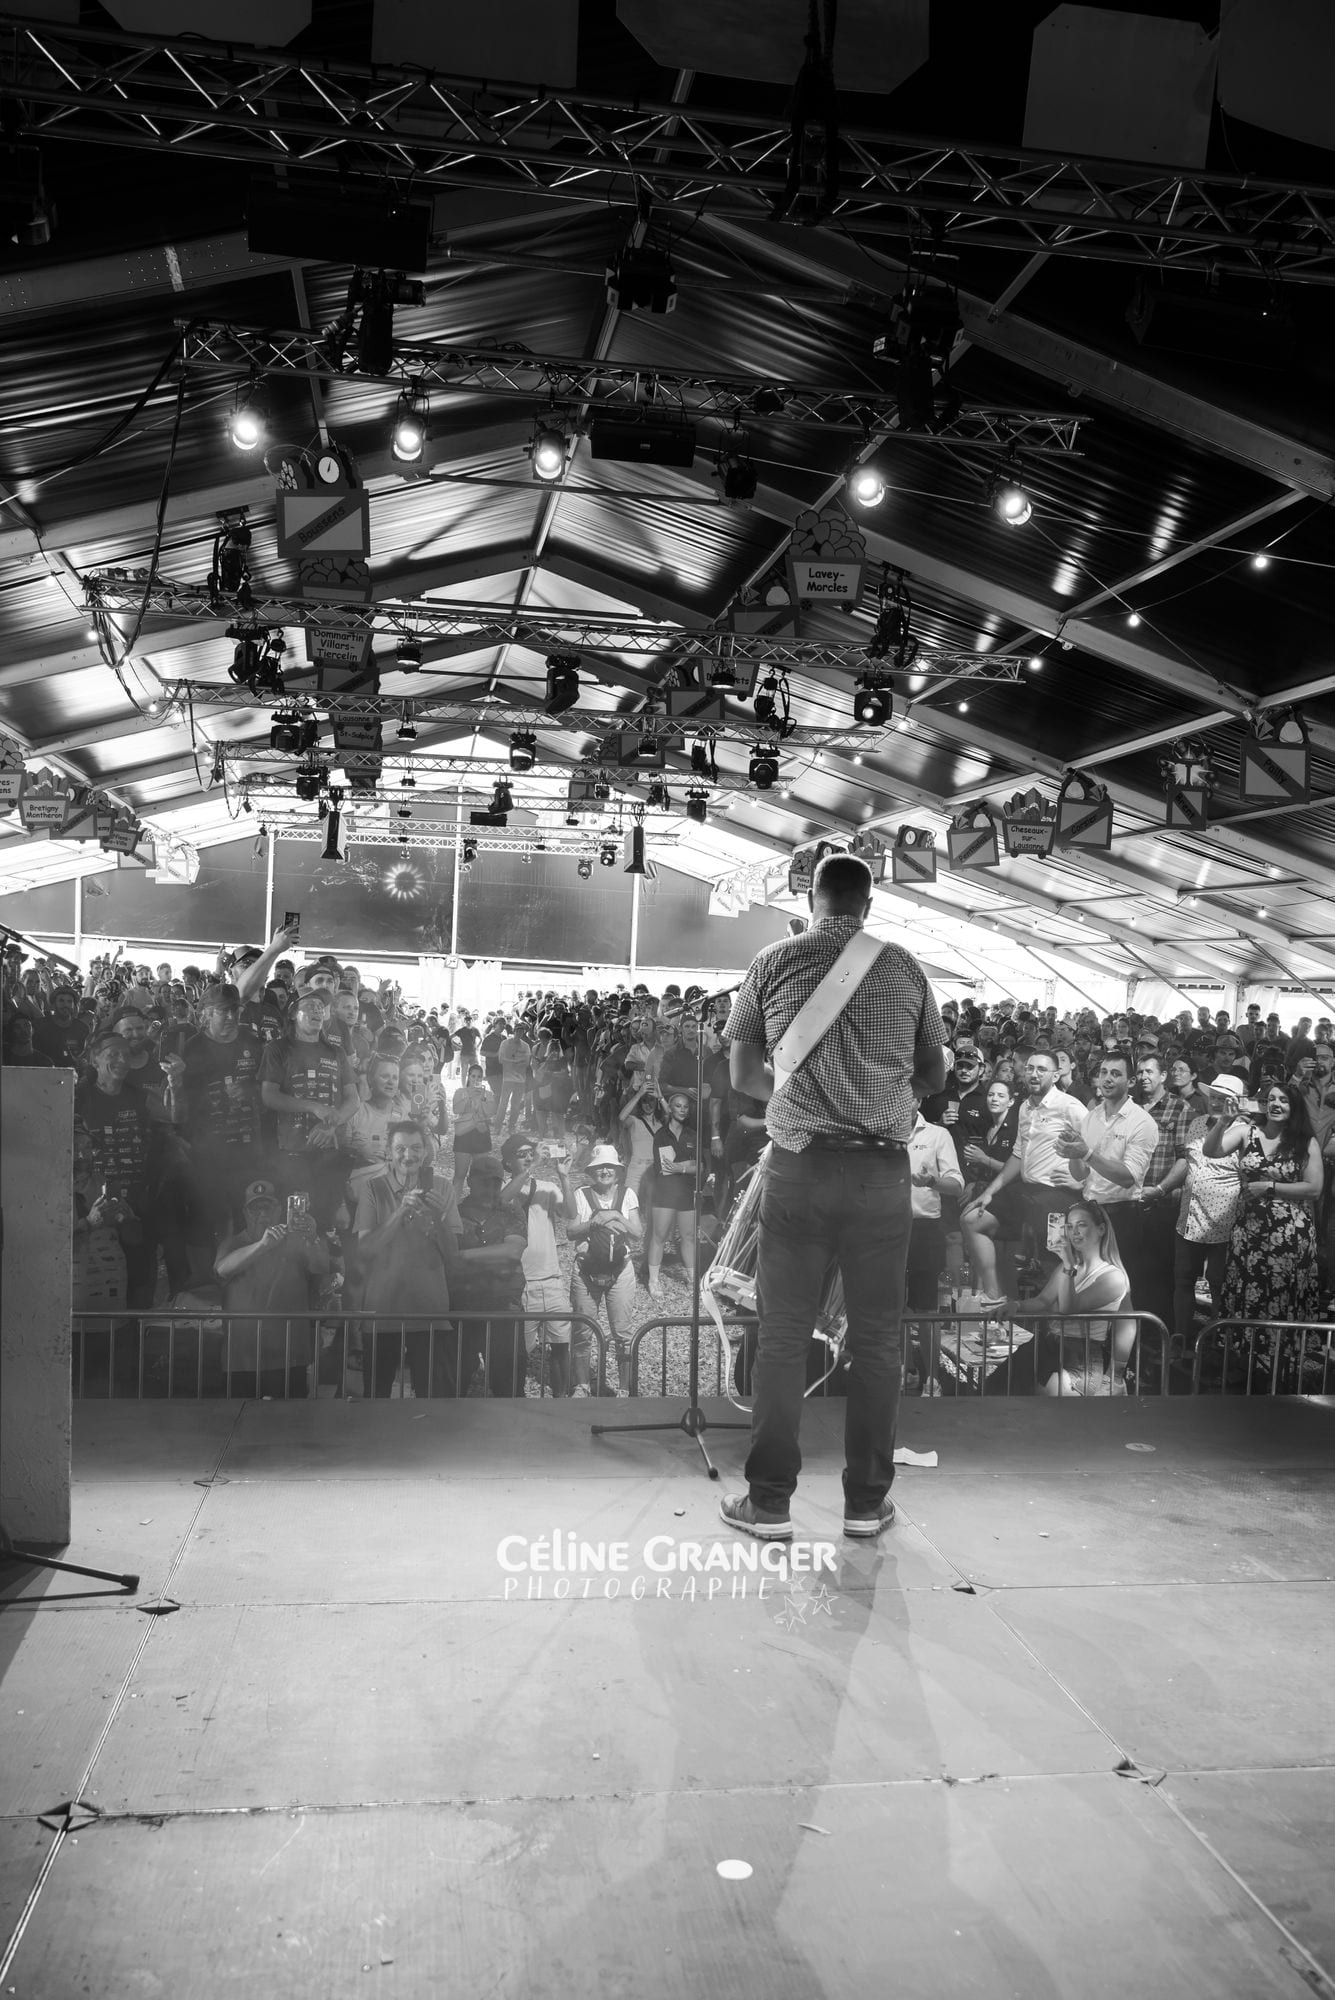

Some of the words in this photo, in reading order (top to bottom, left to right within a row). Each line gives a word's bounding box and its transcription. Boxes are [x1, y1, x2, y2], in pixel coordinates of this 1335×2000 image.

[298, 506, 346, 543] Boussens
[809, 567, 845, 581] Lavey-
[806, 581, 848, 593] Morcles
[314, 629, 364, 643] Dommartin
[320, 639, 355, 650] Villars-
[317, 648, 358, 661] Tiercelin
[338, 714, 370, 722] Lausanne
[1263, 758, 1288, 785] Pailly
[29, 804, 60, 813] Bretigny
[1174, 793, 1196, 821] Brent
[26, 811, 63, 819] Montheron
[1010, 826, 1049, 835] Cheseaux-
[1021, 834, 1037, 842] sur-
[1013, 841, 1045, 851] Lausanne
